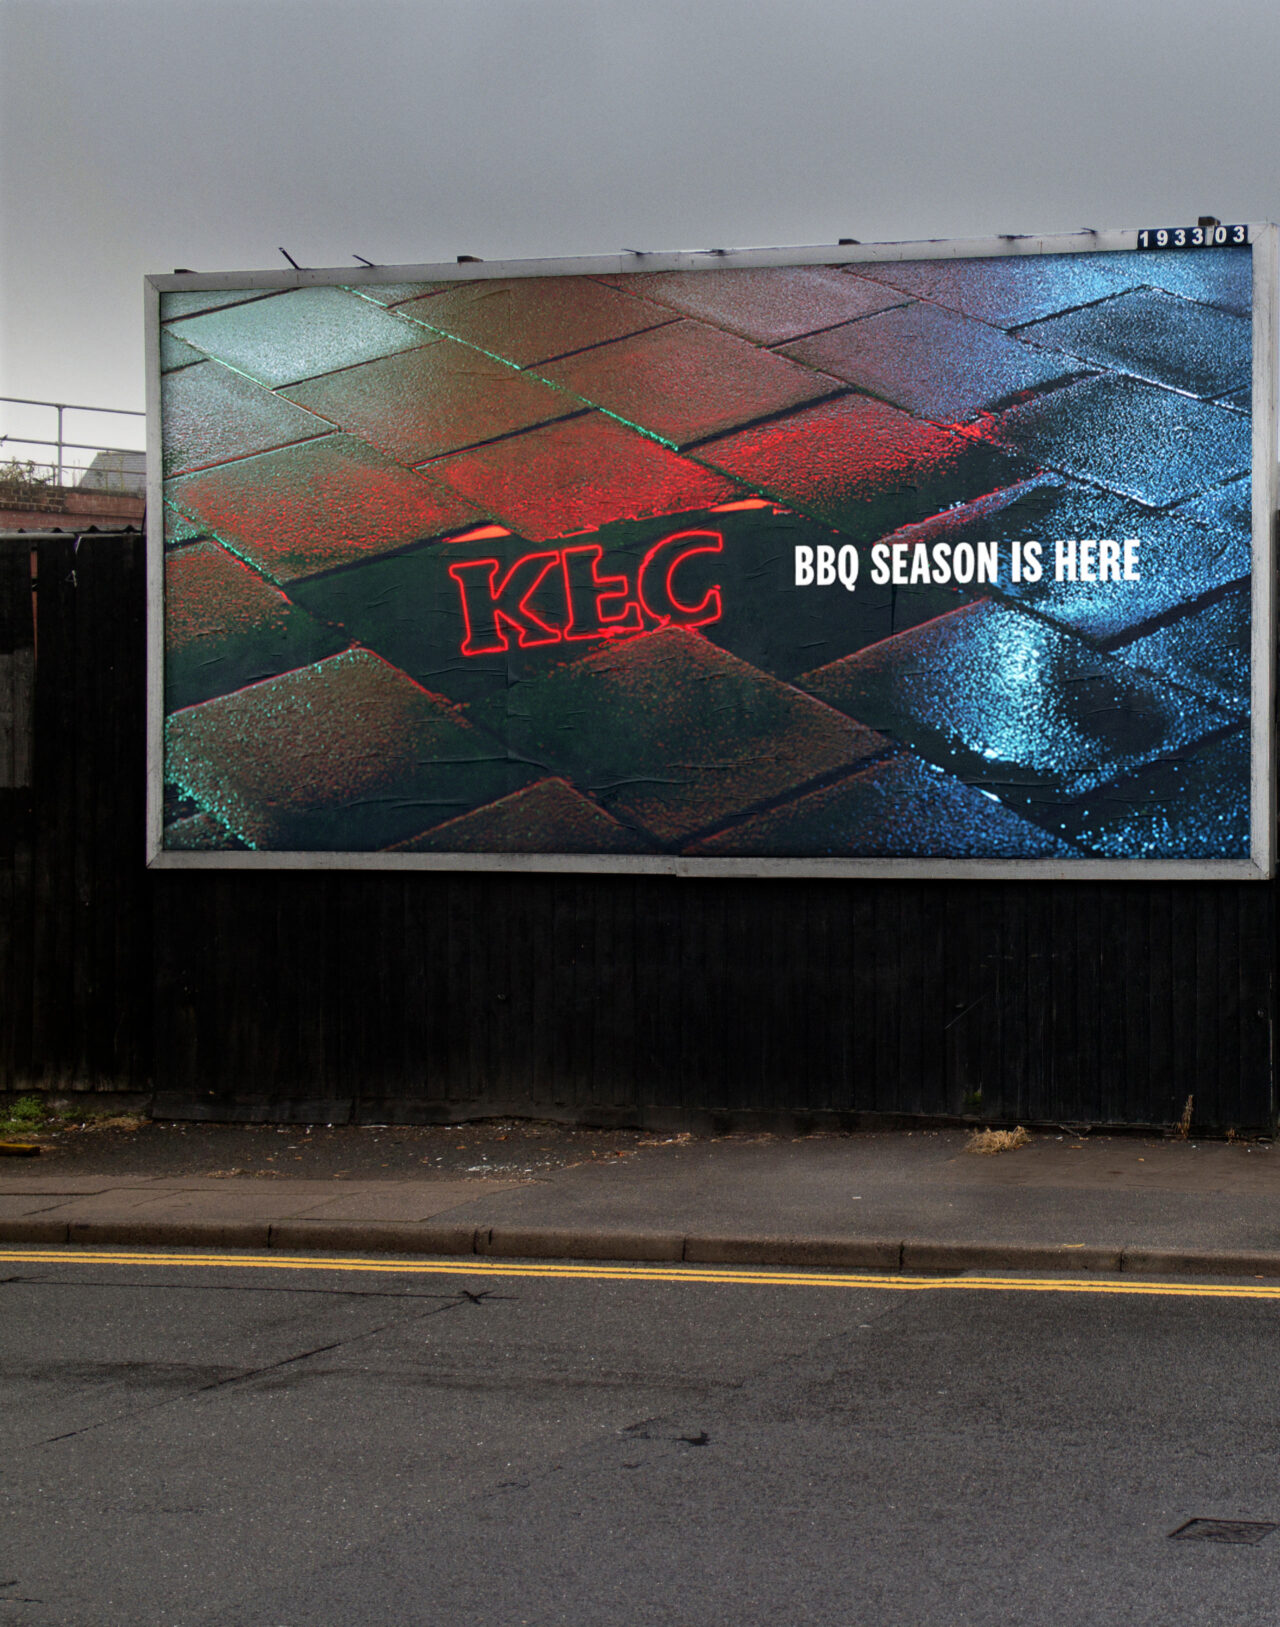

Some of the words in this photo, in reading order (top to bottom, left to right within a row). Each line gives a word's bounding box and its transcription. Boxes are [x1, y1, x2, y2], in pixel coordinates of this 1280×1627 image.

[795, 544, 859, 592] BBQ
[871, 541, 998, 585] SEASON
[1011, 540, 1043, 583] IS
[1055, 539, 1141, 582] HERE
